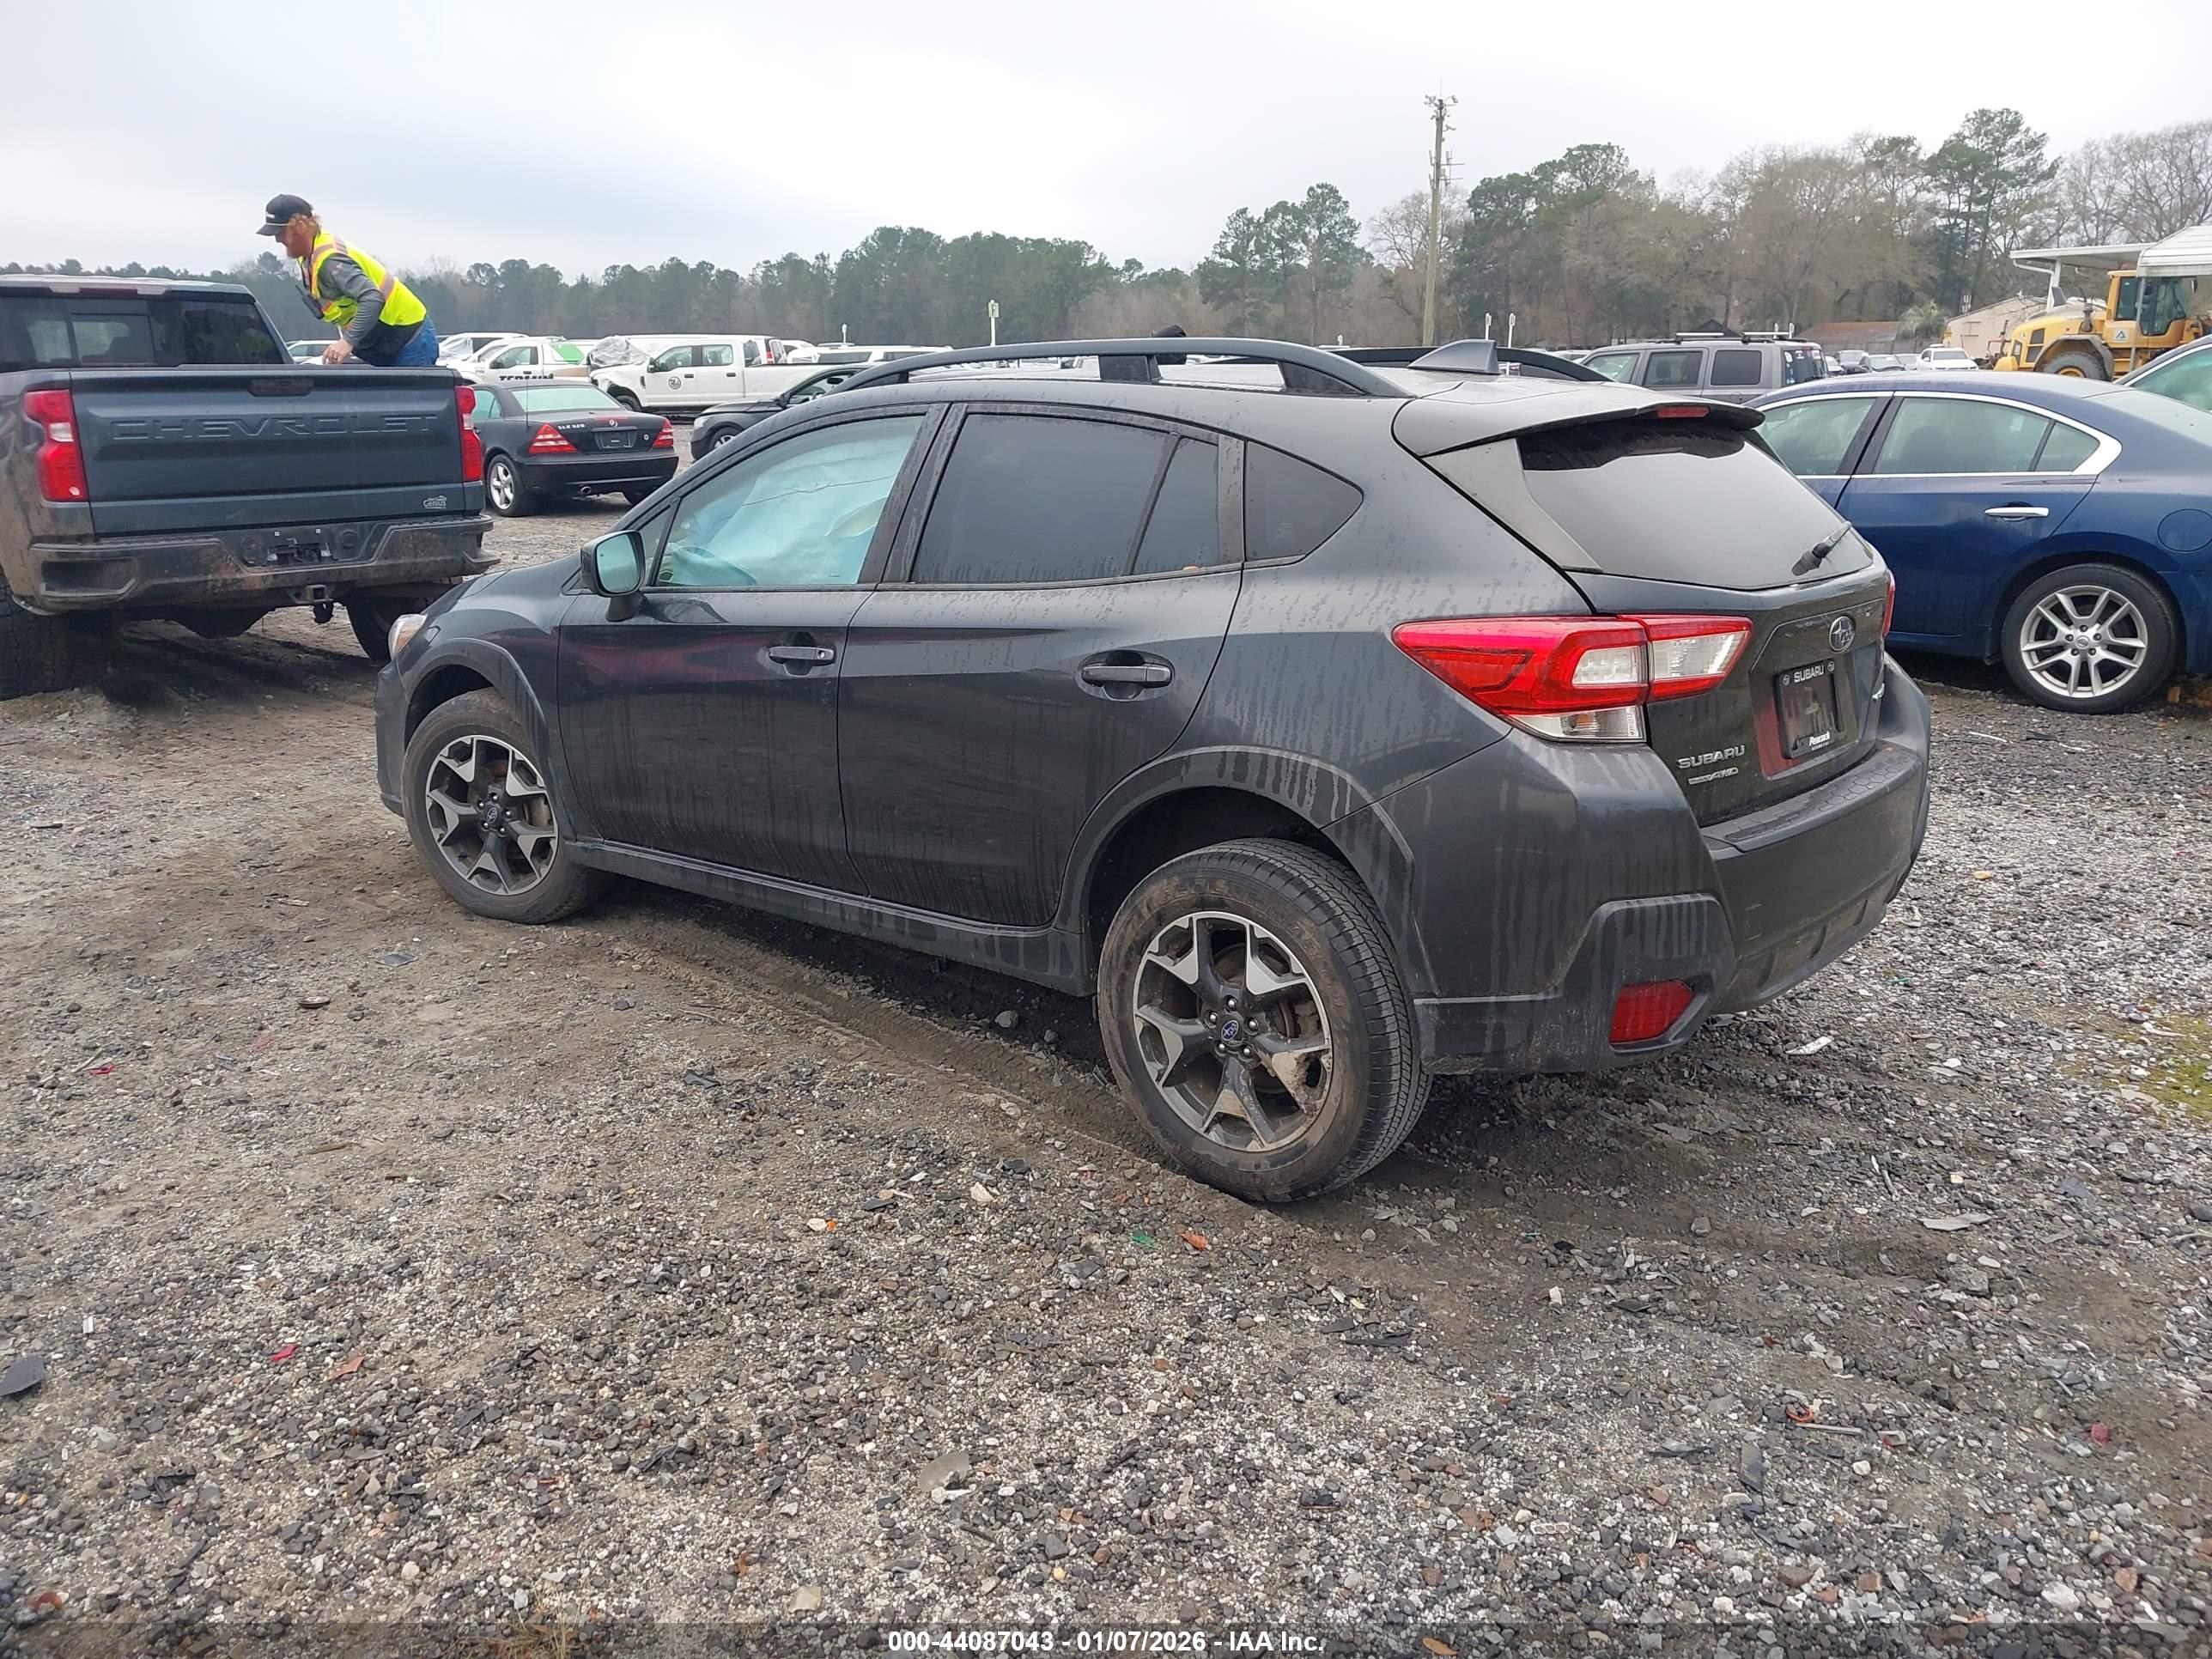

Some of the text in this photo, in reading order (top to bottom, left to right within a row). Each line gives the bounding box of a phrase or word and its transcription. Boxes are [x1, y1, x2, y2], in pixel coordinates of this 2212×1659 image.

[110, 415, 438, 440] CHEVROLET
[1793, 665, 1825, 684] SUBARU
[1676, 744, 1746, 769] SUBARU
